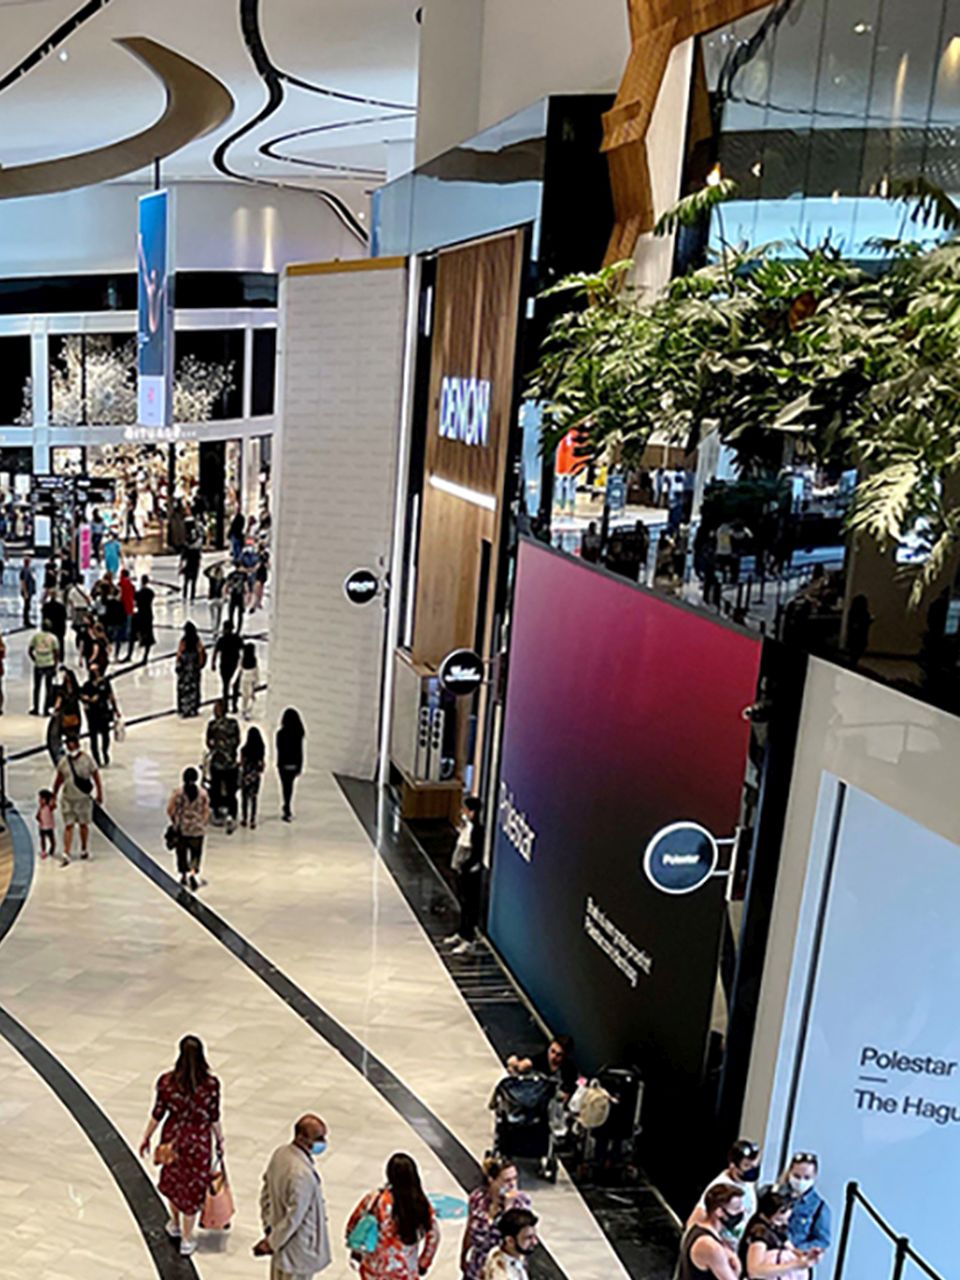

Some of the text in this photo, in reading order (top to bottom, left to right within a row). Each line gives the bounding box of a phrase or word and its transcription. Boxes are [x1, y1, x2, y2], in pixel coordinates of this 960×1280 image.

[439, 376, 490, 447] DENON
[860, 1047, 958, 1076] Polestar
[853, 1089, 898, 1114] The
